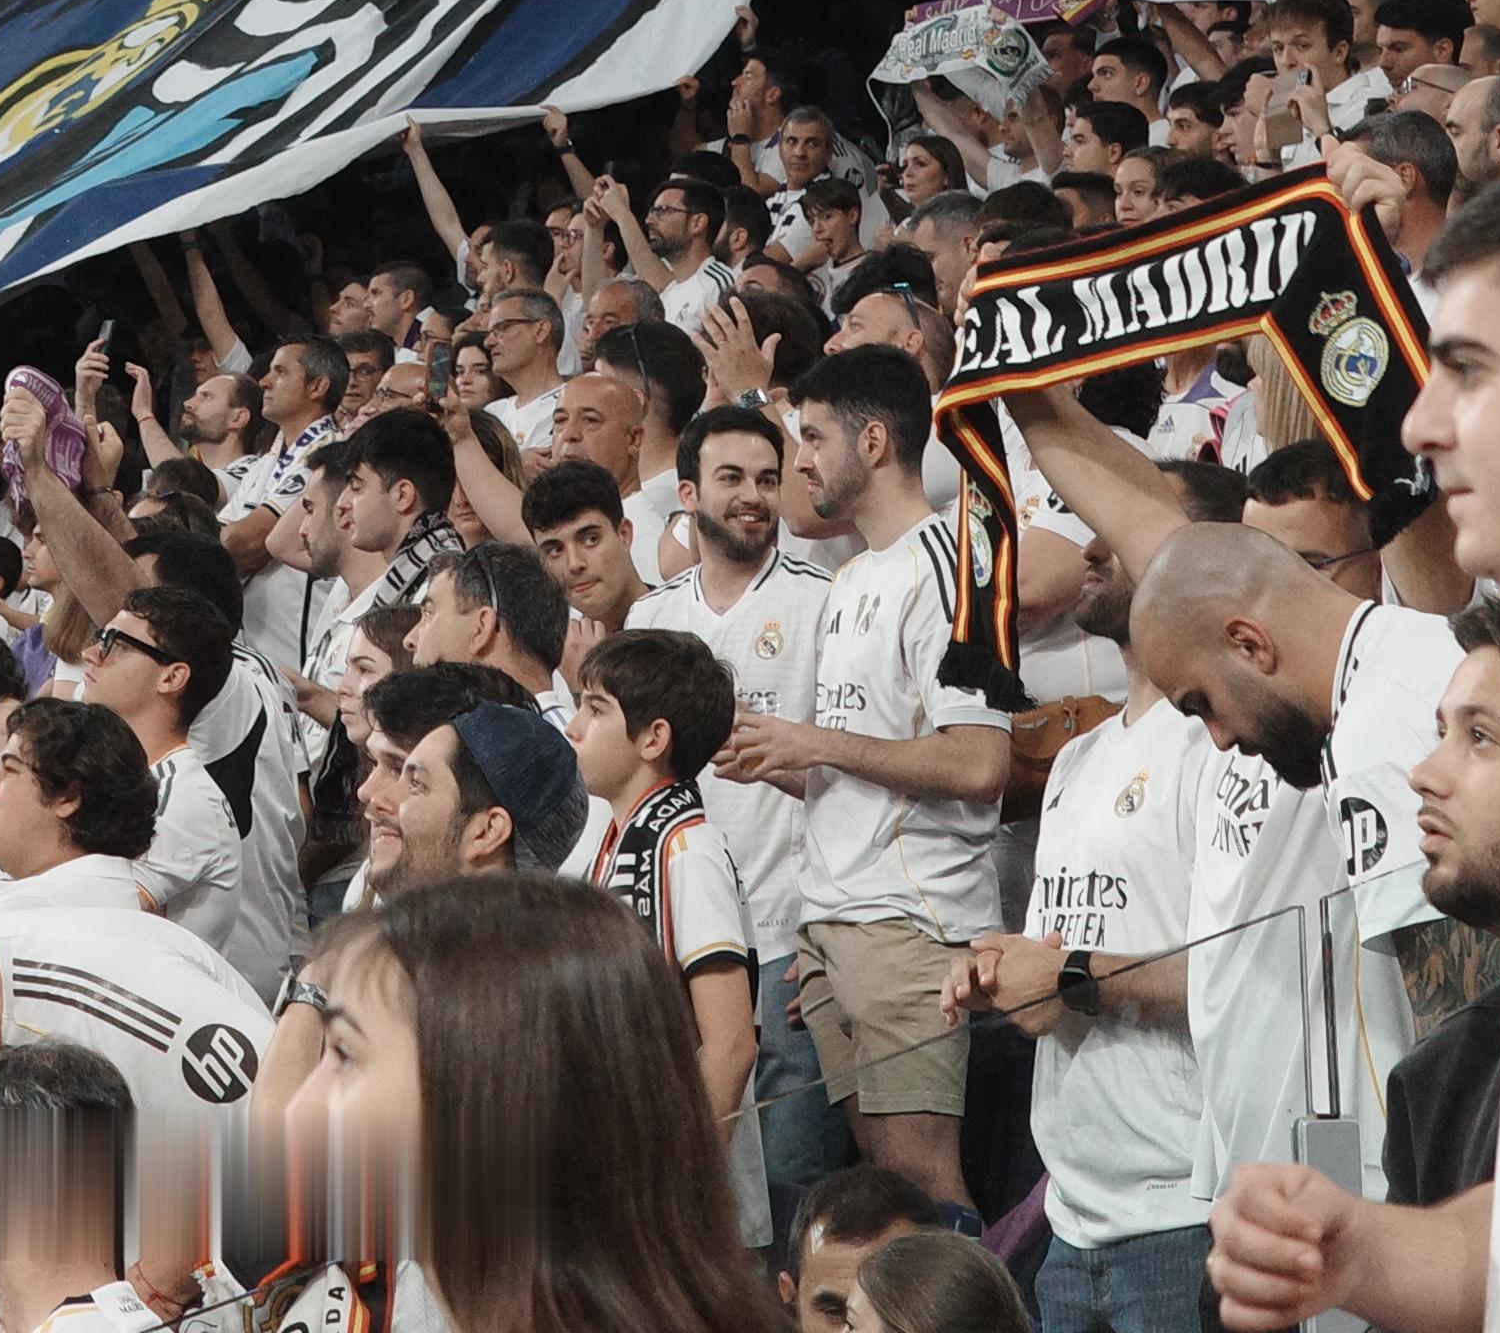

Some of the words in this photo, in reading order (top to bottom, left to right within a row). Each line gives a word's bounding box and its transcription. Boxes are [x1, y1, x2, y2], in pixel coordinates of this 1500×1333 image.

[929, 23, 980, 56] Madrid
[950, 288, 1066, 378] EAL
[186, 1024, 259, 1104] hp
